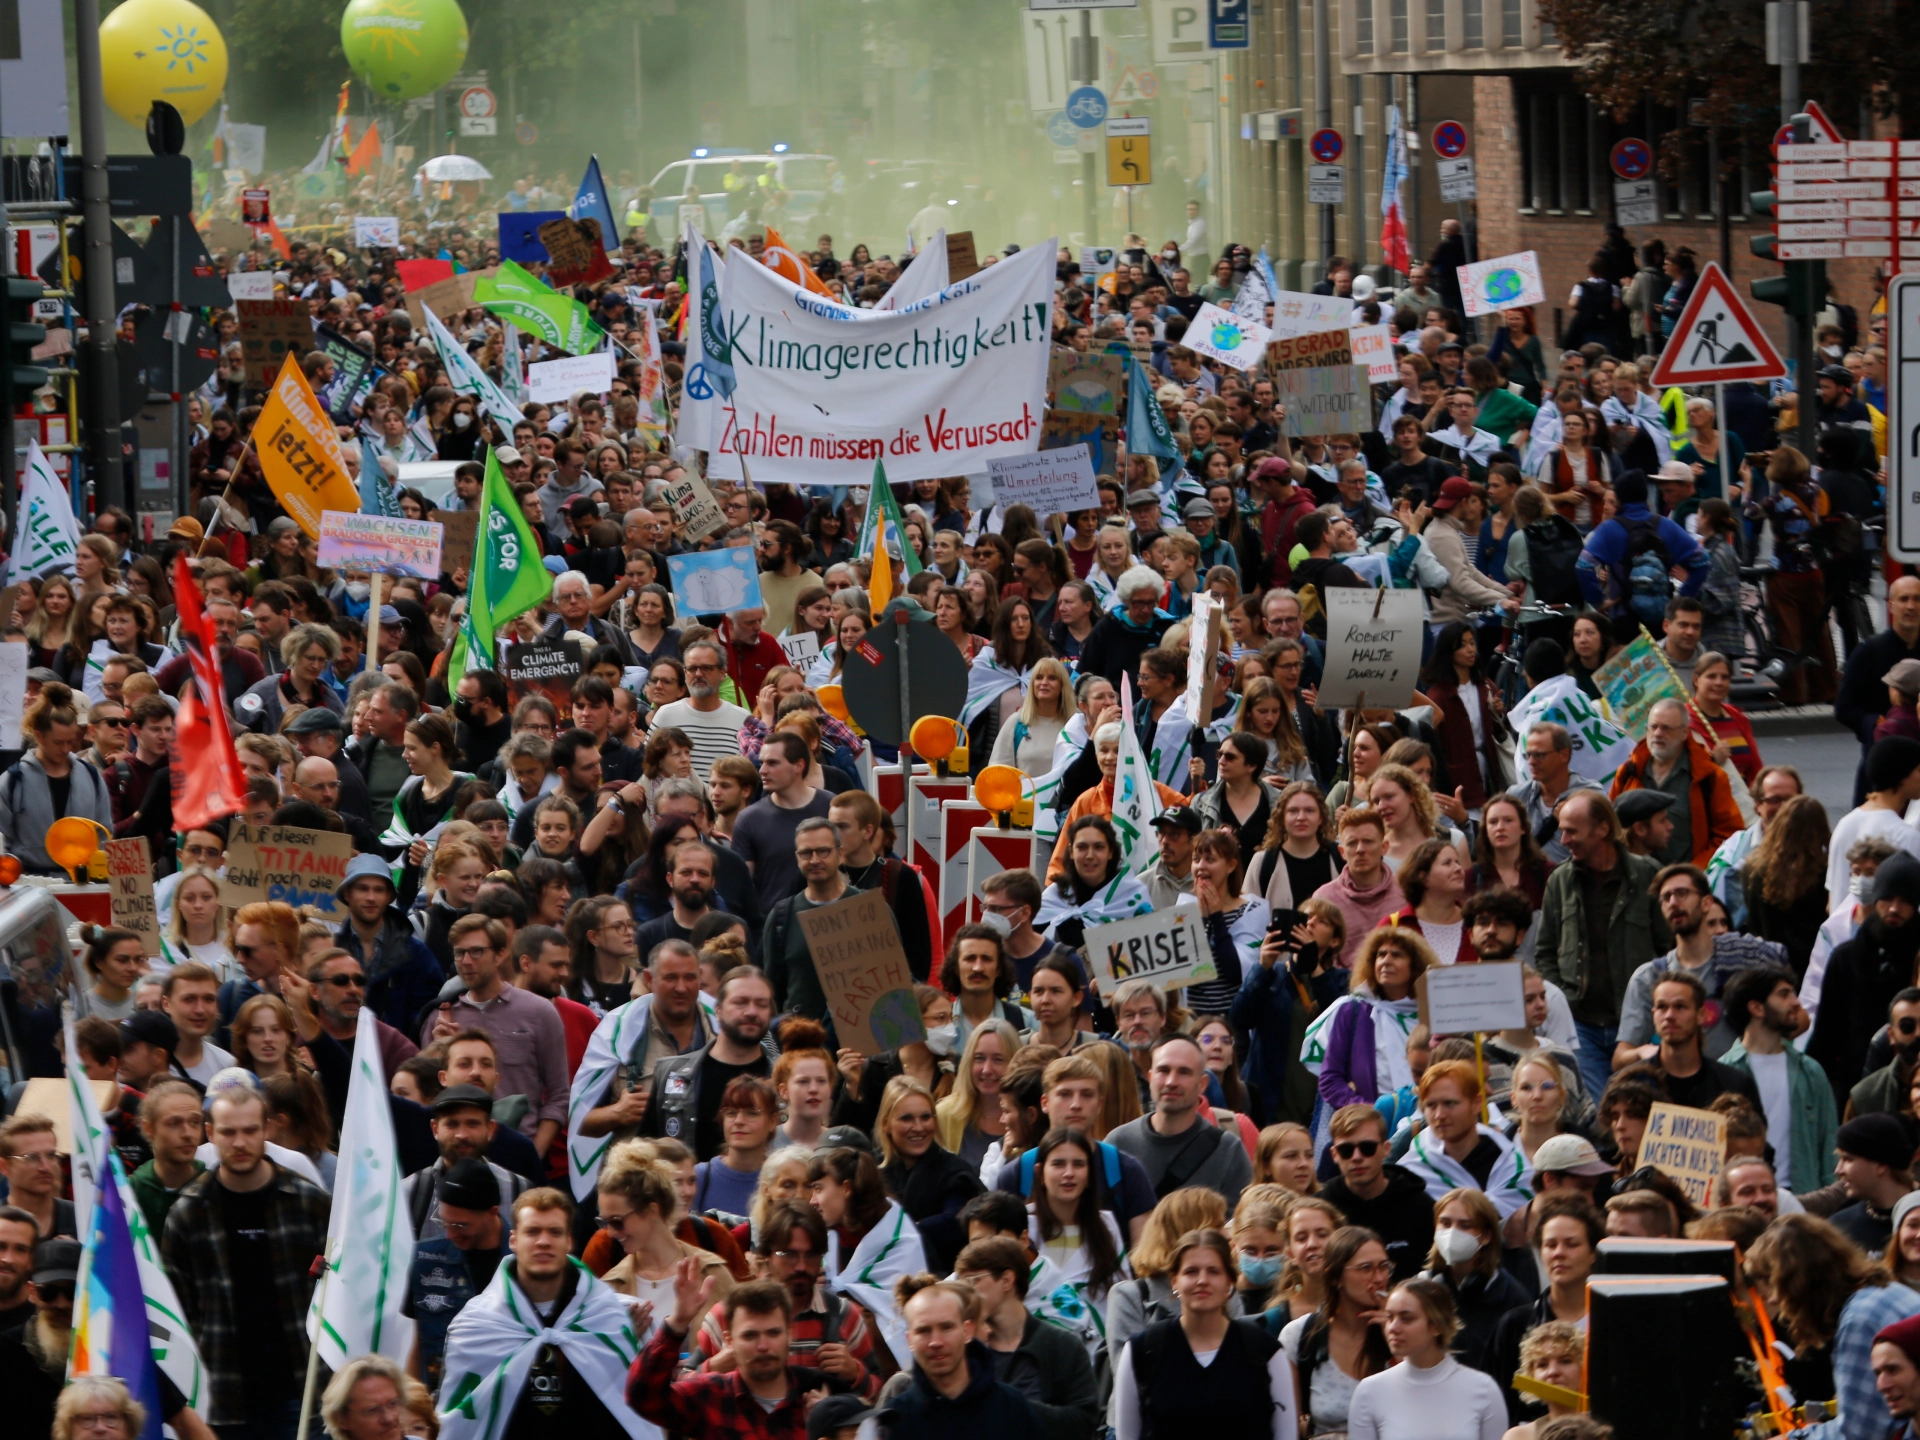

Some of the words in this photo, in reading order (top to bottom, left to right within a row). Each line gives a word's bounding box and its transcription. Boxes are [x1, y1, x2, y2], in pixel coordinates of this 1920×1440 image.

[1171, 6, 1197, 39] P
[1122, 138, 1133, 152] U
[236, 300, 296, 318] VEGAN
[729, 302, 1046, 380] Klimagerechtigkeit!
[1295, 330, 1344, 355] GRAD
[1352, 334, 1384, 356] KEIN
[1316, 349, 1350, 368] WIRD
[1279, 370, 1301, 394] NO
[1309, 366, 1369, 393] FUTURE
[1299, 392, 1356, 414] WITHOUT
[718, 406, 804, 458] Zahlen
[810, 433, 884, 460] müssen
[889, 427, 922, 456] die
[267, 417, 336, 493] jetzt!
[1005, 469, 1079, 489] Umverteilung
[324, 514, 440, 538] ERWACHSENE
[686, 505, 721, 535] PROBLEM!
[323, 527, 384, 543] BRAUCHEN
[386, 534, 439, 549] GRENZEN
[1345, 624, 1403, 643] ROBERT
[521, 651, 566, 667] CLIMATE
[781, 639, 806, 658] N'T
[1351, 648, 1395, 663] HALTE
[510, 661, 580, 680] EMERGENCY!
[272, 826, 319, 844] dieser
[107, 859, 147, 876] CHANGE
[225, 866, 260, 888] fehlt
[308, 874, 334, 890] die
[120, 877, 137, 895] NO
[112, 895, 154, 915] CLIMATE
[268, 884, 338, 913] PANIK
[858, 902, 876, 923] GO
[815, 929, 897, 967] BREAKING
[824, 970, 847, 993] MY
[836, 962, 902, 1028] EARTH
